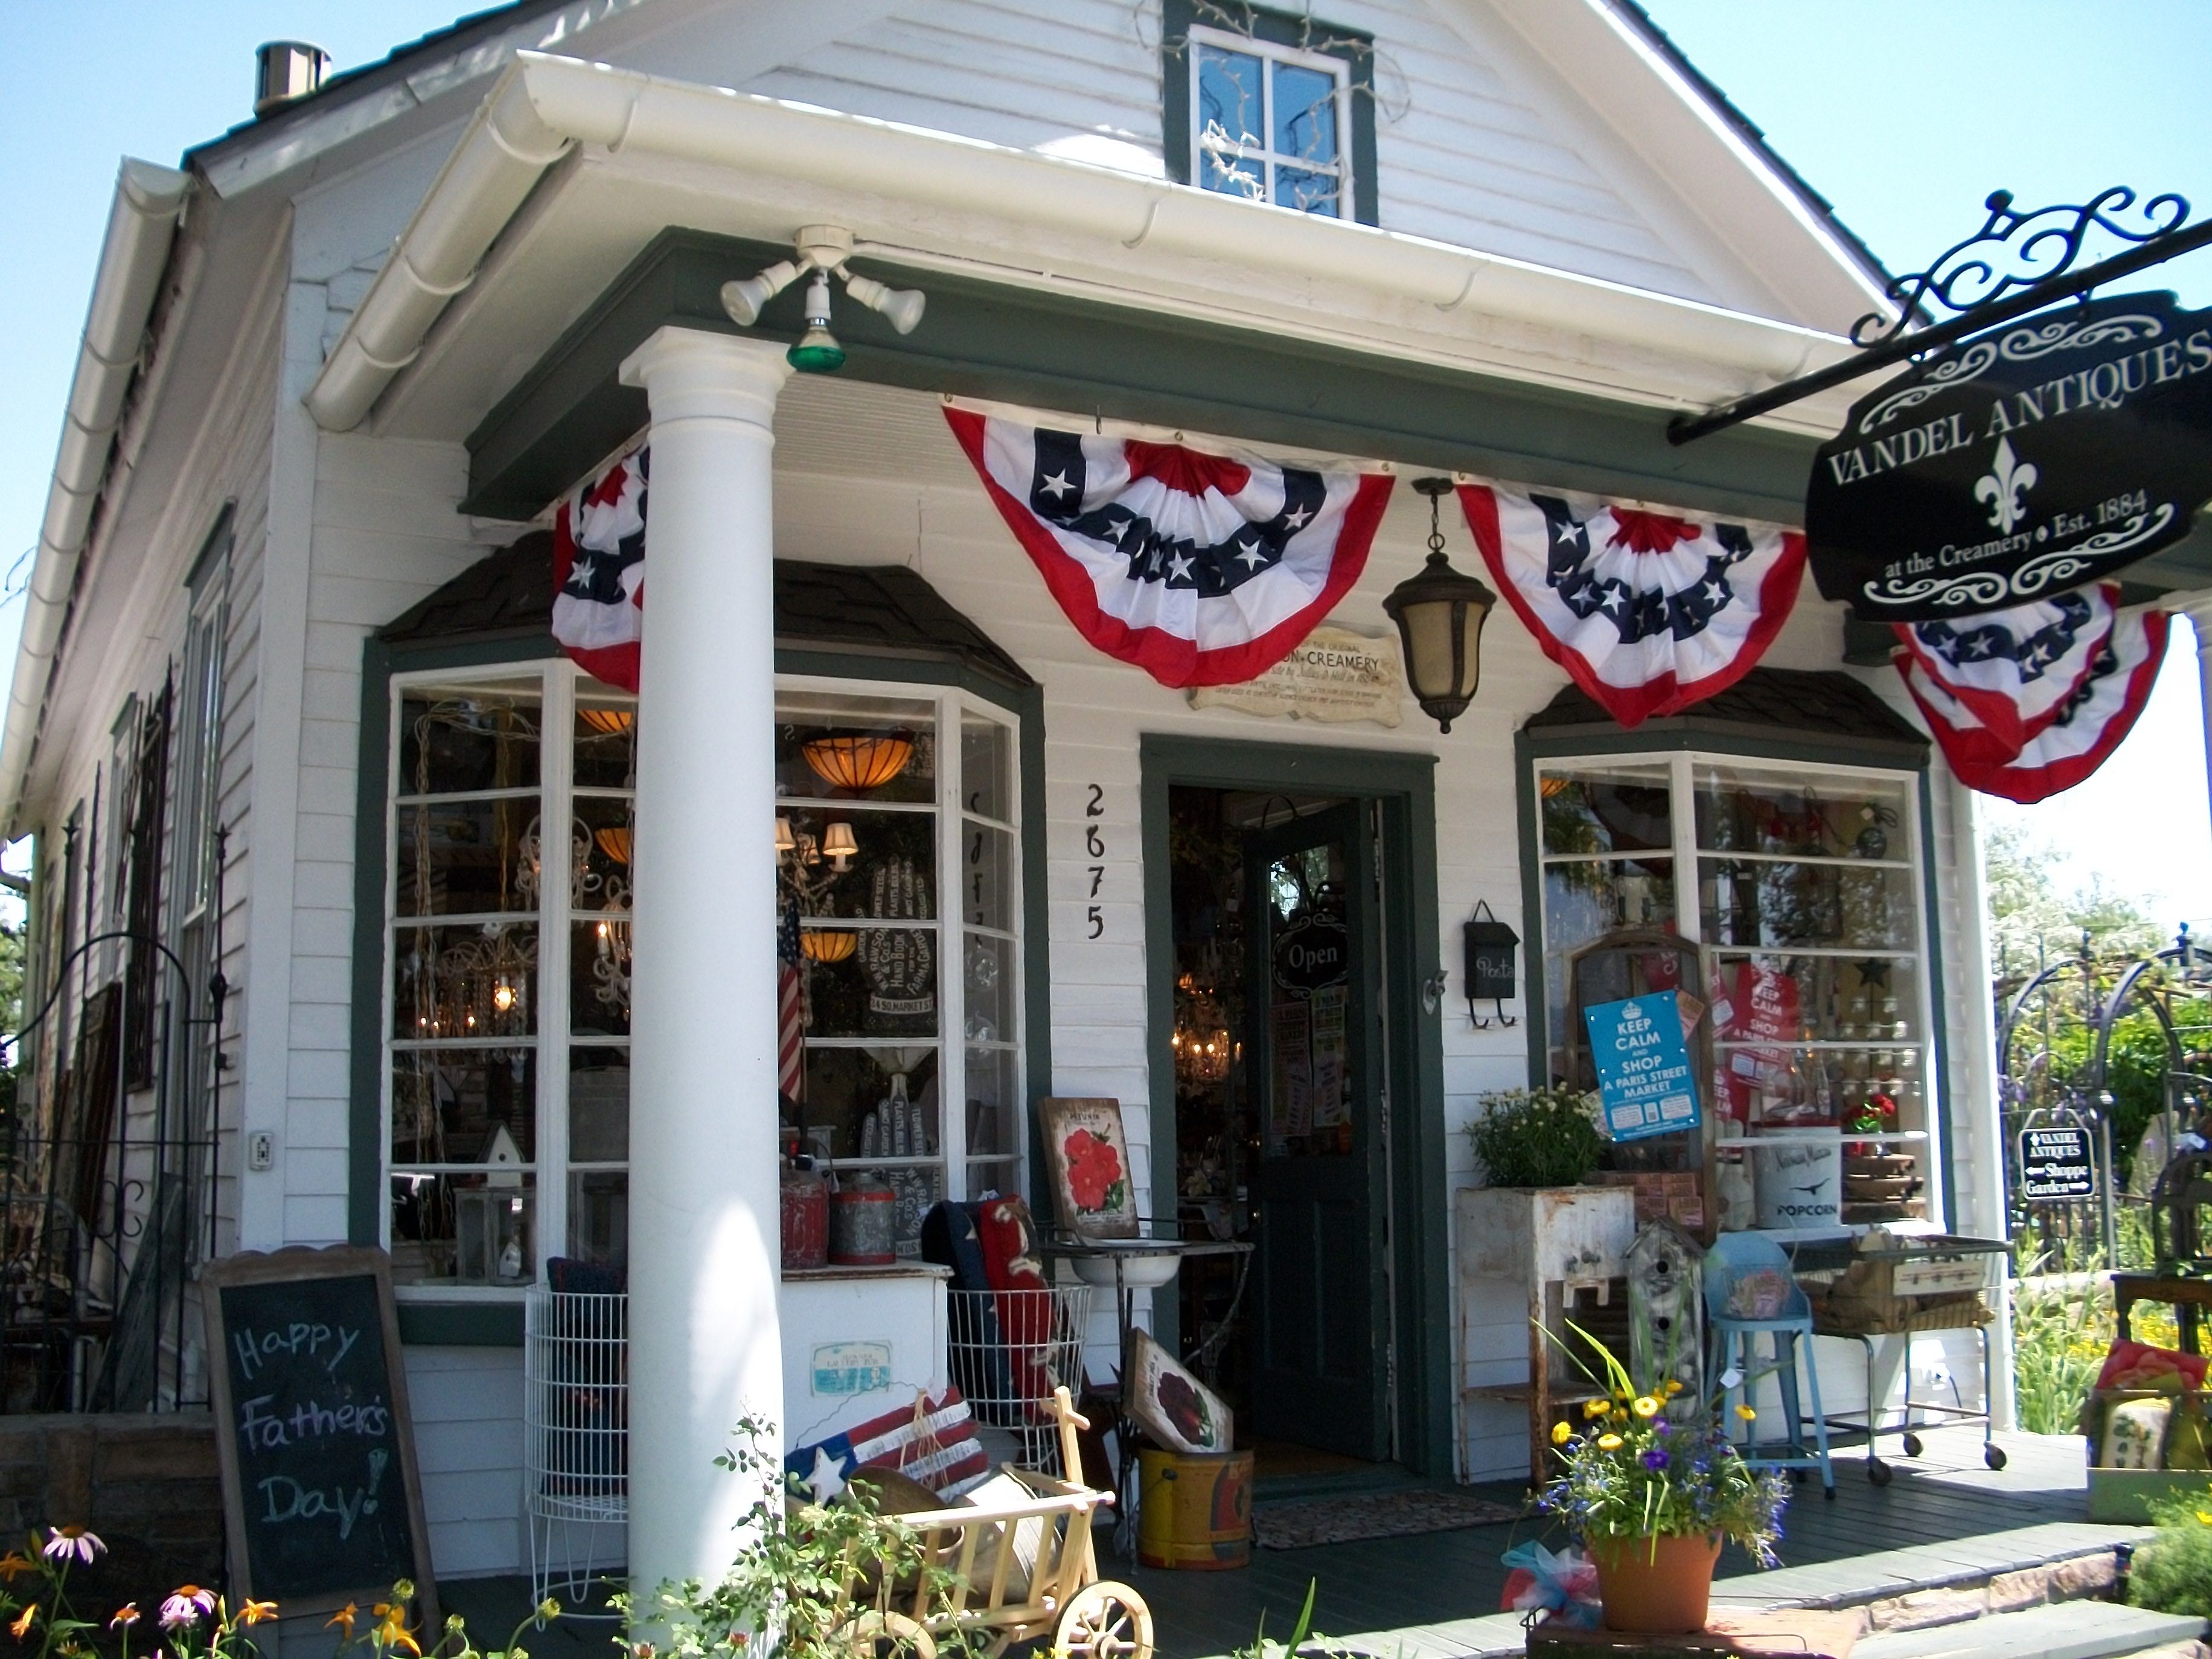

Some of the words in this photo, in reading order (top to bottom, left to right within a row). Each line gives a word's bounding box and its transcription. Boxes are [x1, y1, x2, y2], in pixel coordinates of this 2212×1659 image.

[1828, 412, 1974, 486] VANDEL
[1983, 329, 2212, 440] ANTIQUES
[1885, 560, 1902, 579] at
[1906, 551, 1936, 575] the
[1939, 525, 2033, 568] Creamery
[2053, 511, 2091, 538] Est.
[2097, 489, 2148, 525] 1884
[1307, 651, 1380, 673] CREAMERY
[1288, 944, 1338, 973] Open
[1617, 1018, 1652, 1035] KEEP
[1750, 1018, 1779, 1035] SHOP
[1615, 1031, 1661, 1051] CALM
[1622, 1055, 1663, 1074] SHOP
[1604, 1081, 1613, 1091] A
[1616, 1073, 1647, 1088] PARIS
[1651, 1066, 1688, 1081] STREET
[1624, 1081, 1671, 1099] MARKET
[1777, 1204, 1837, 1216] POPCORN
[234, 1322, 360, 1380] Happy
[257, 1449, 389, 1540] Day!
